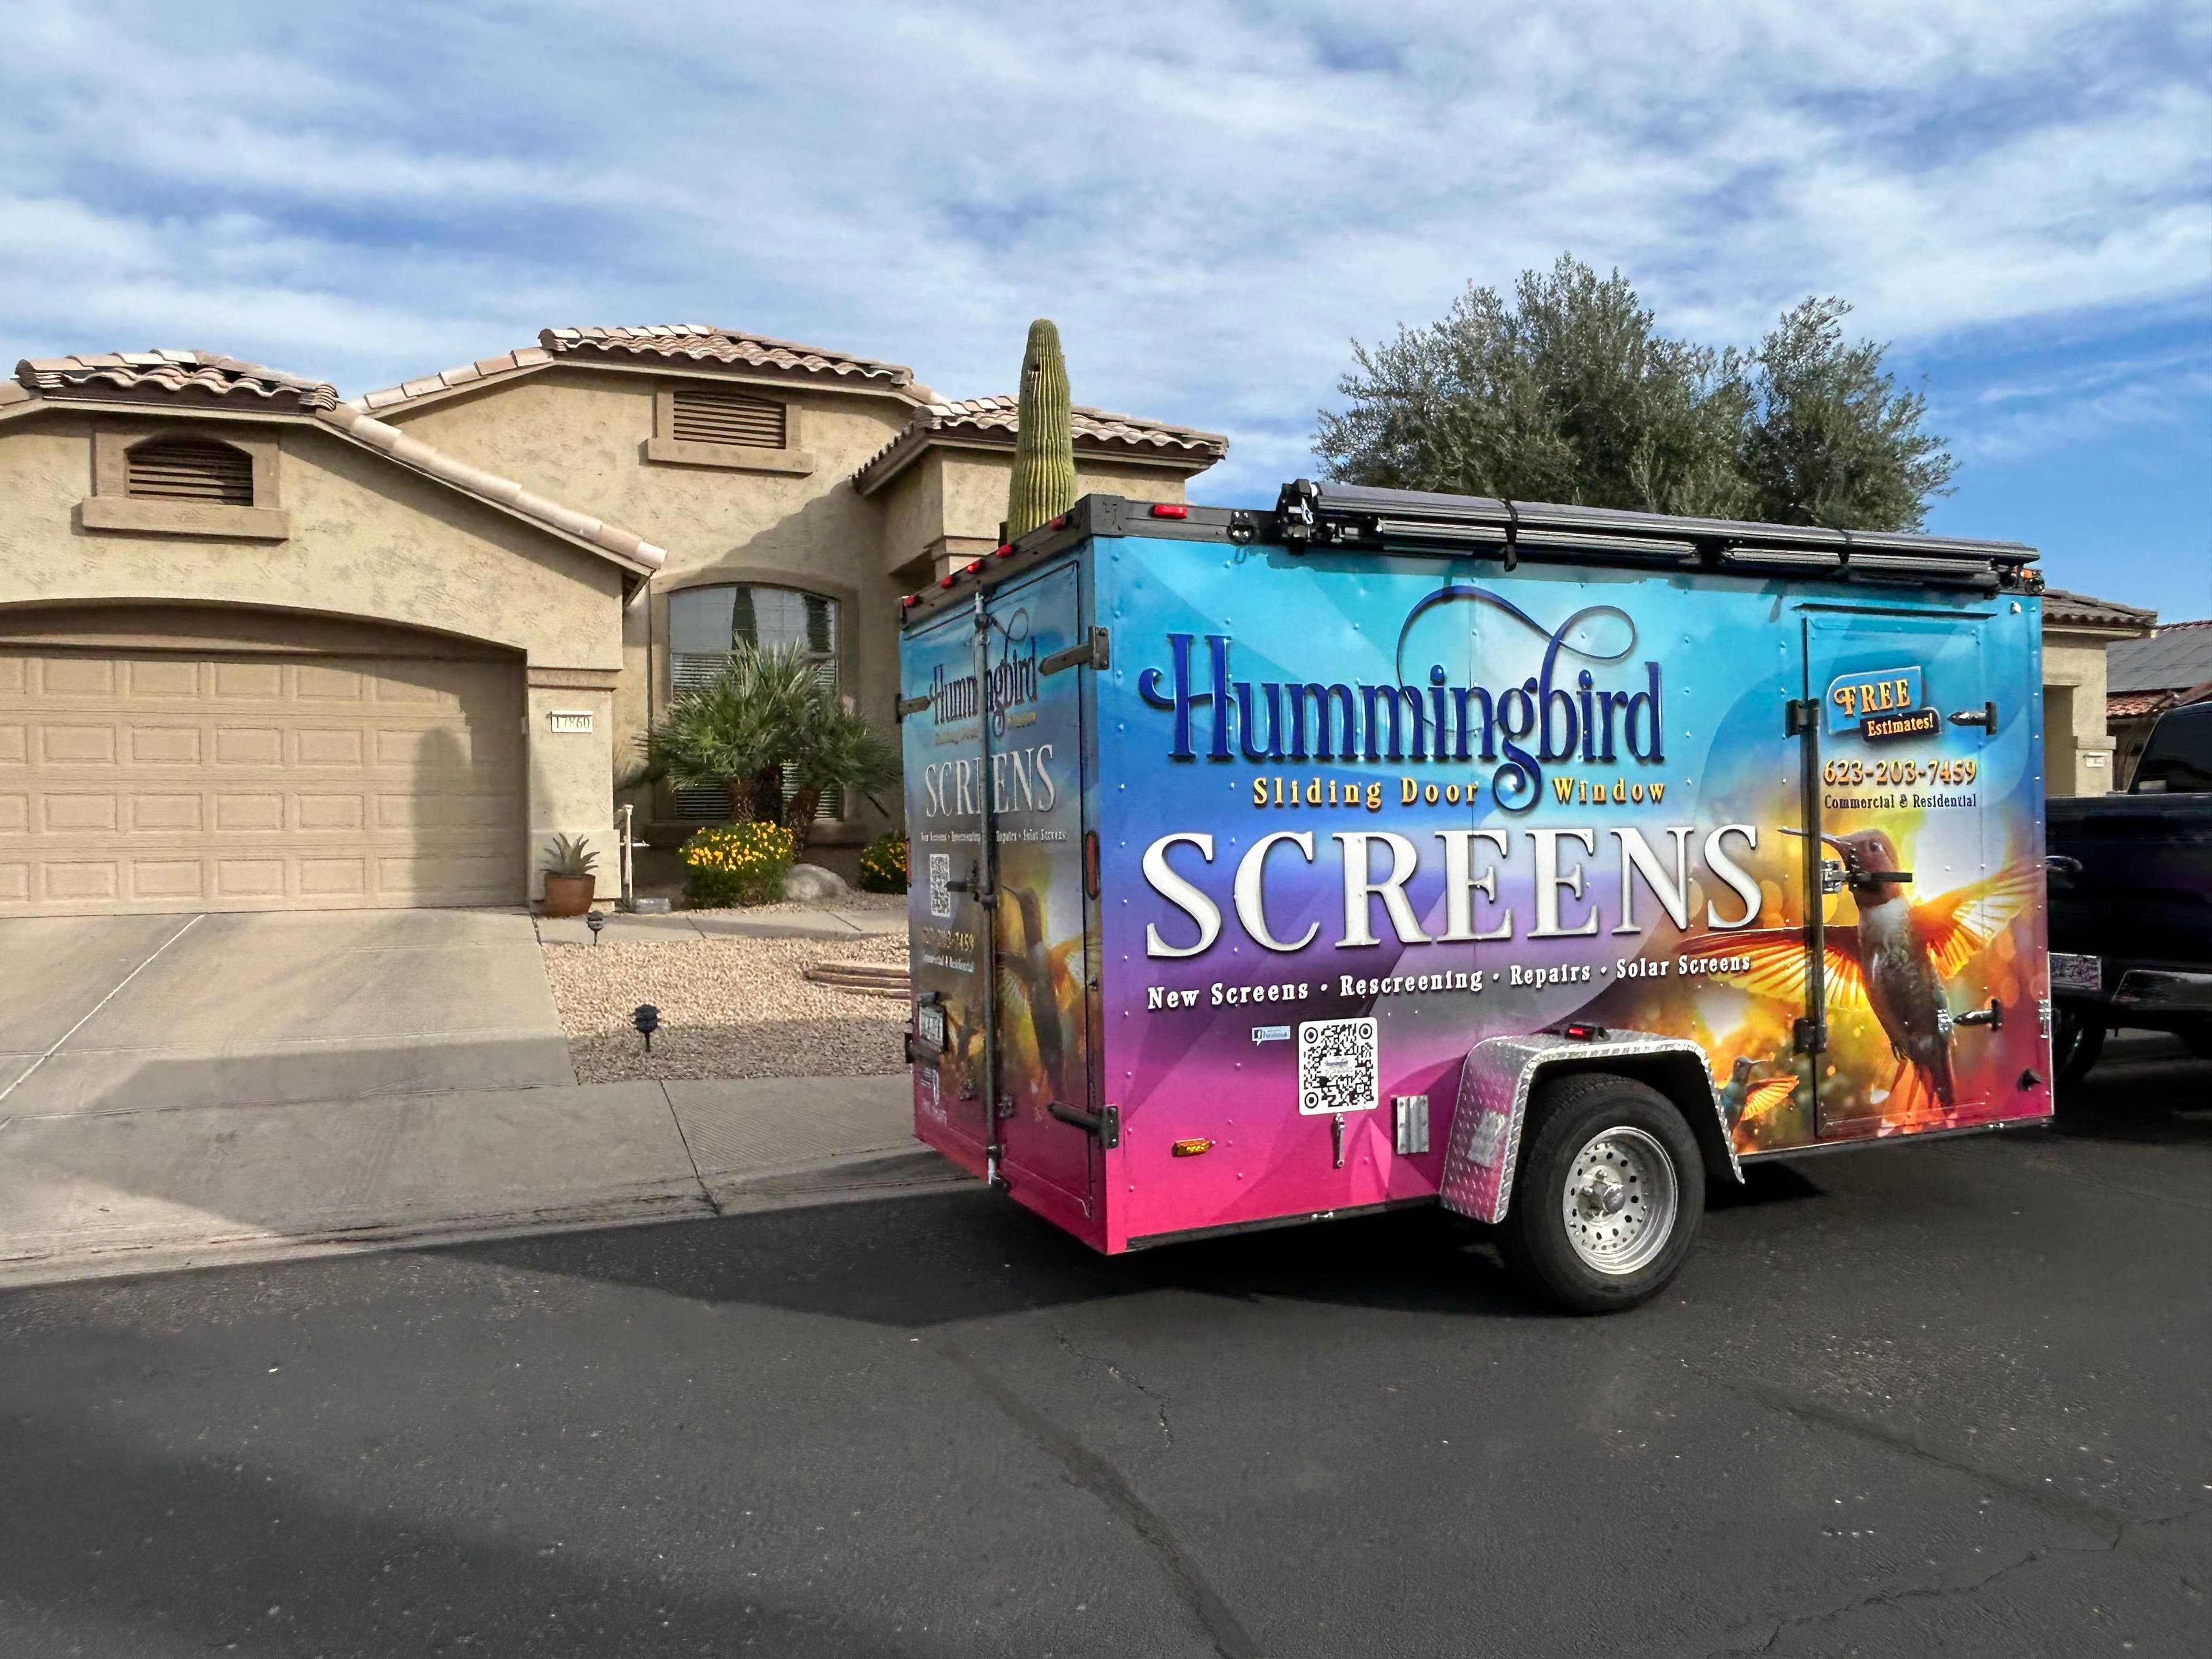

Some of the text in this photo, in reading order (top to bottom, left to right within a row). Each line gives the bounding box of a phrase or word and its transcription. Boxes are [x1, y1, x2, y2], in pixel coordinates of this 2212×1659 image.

[929, 608, 1037, 737] Hummngbird
[1138, 585, 1666, 810] Hummingbird
[1834, 679, 1911, 717] FREE
[1867, 713, 1934, 737] Estimates!
[1823, 759, 1977, 786] 623-203-7459
[1253, 777, 1666, 809] Sliding Door Window
[1824, 794, 1895, 809] Commercial
[1912, 794, 1976, 808] Residential
[1141, 824, 1764, 958] SCREENS
[1147, 954, 1752, 1010] New Screens Rescreening Repairs Solar Screens
